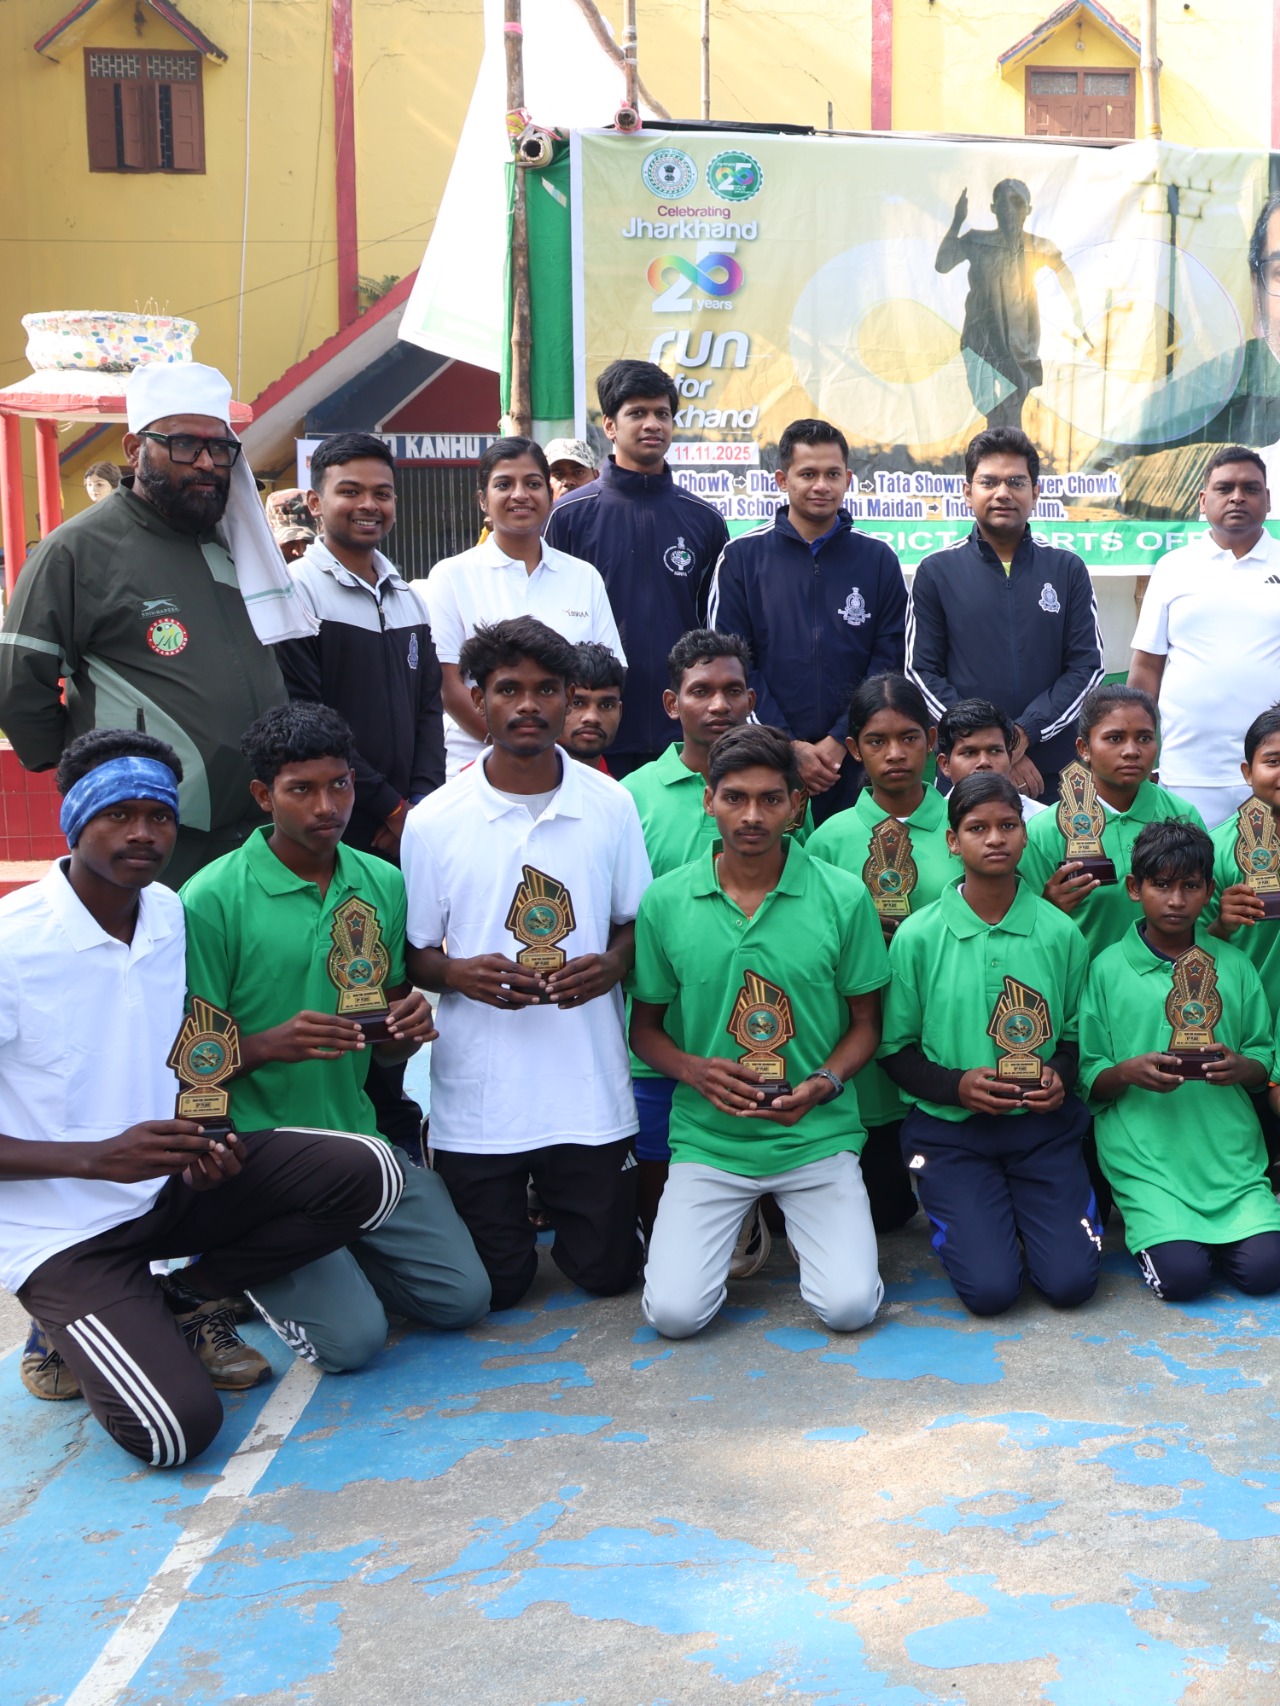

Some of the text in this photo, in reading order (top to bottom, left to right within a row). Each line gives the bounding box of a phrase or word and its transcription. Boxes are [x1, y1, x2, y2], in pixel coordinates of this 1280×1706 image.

[657, 205, 731, 219] Celebrating
[621, 217, 758, 240] Jharkhand
[697, 299, 733, 311] years
[649, 330, 749, 368] run
[405, 436, 480, 459] KANHU
[675, 446, 751, 461] 11.11.2025
[678, 473, 730, 492] Chowk
[878, 474, 911, 493] Tata
[1067, 475, 1118, 494] Chowk
[867, 498, 923, 518] Maidan
